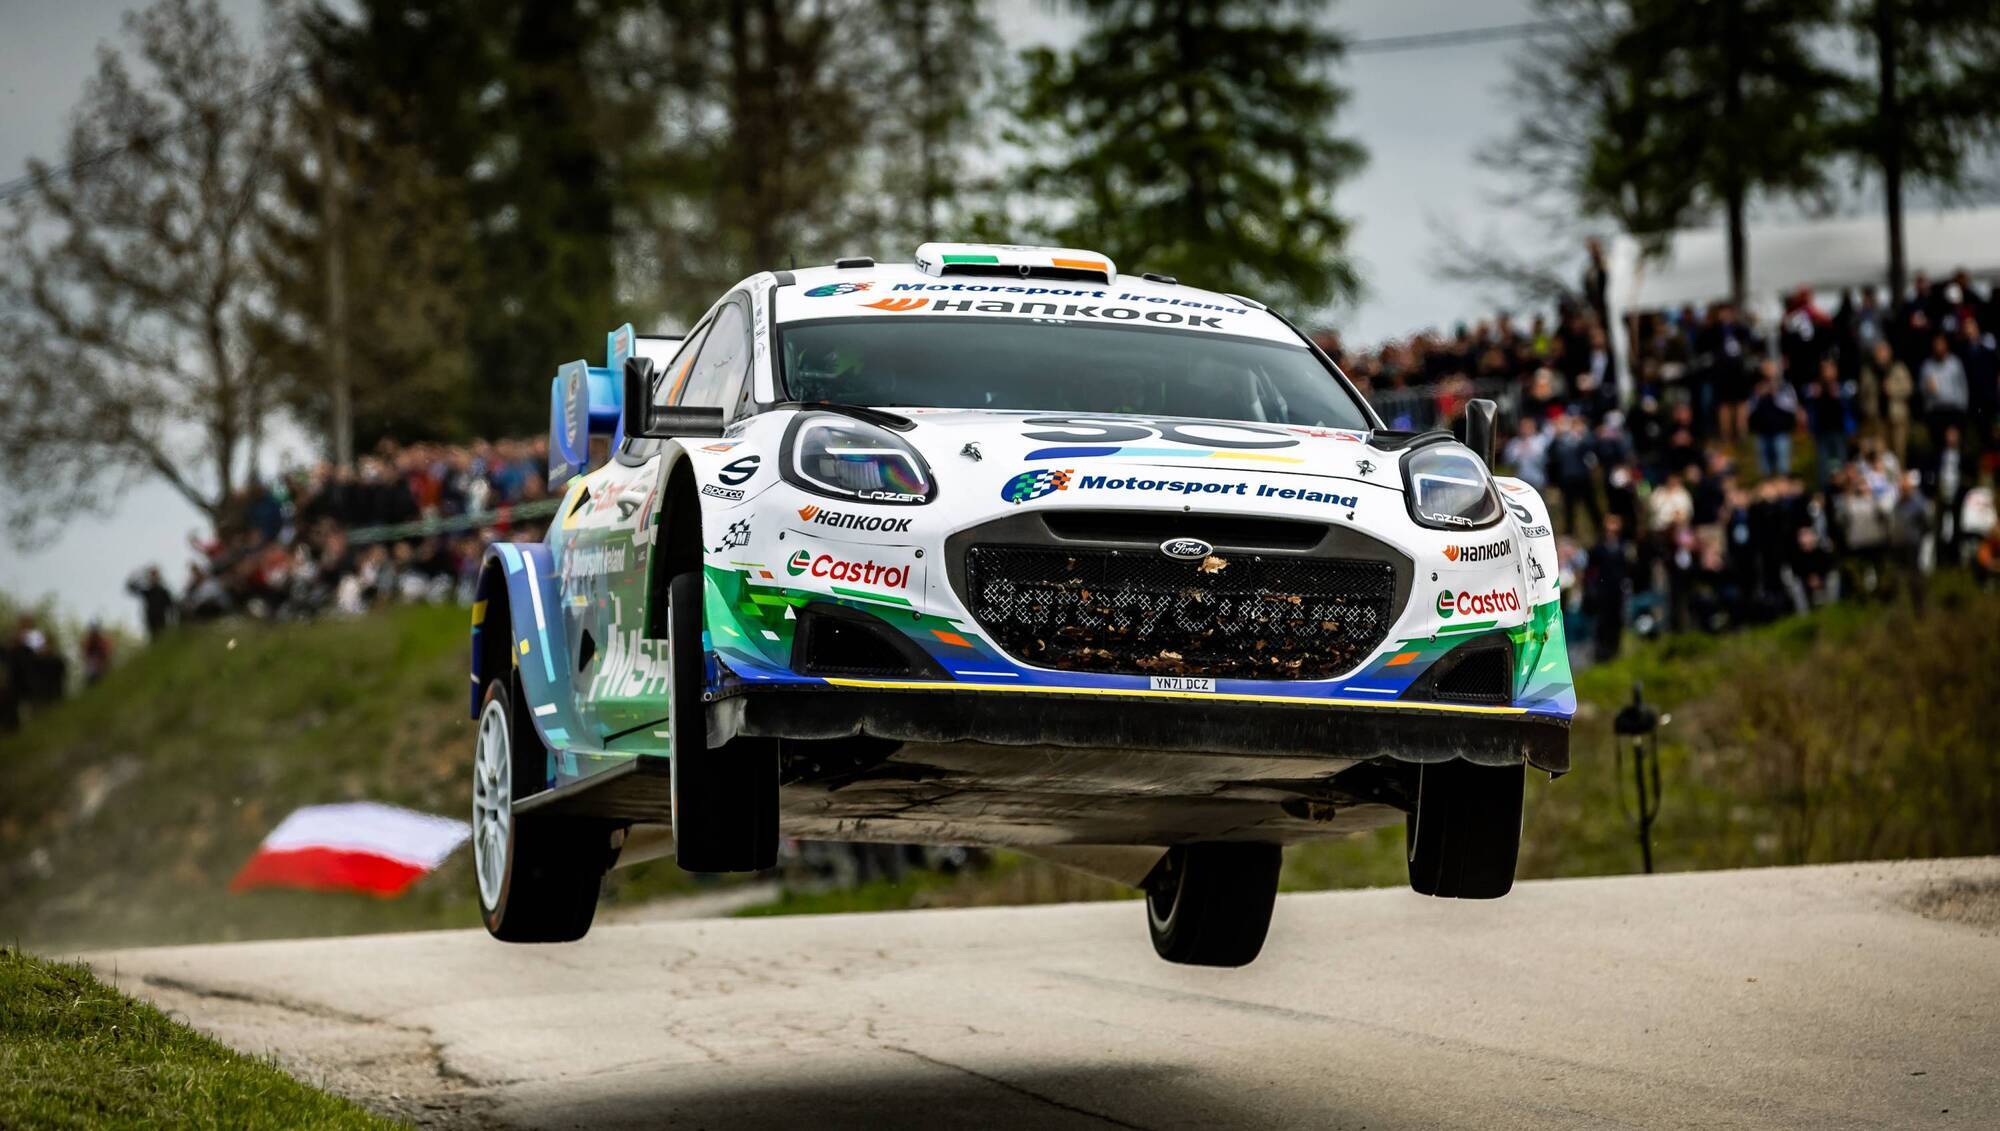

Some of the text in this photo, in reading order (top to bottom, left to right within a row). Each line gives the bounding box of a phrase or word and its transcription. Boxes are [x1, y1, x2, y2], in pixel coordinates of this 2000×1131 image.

[891, 283, 1249, 316] Motorsport Ireland
[703, 485, 744, 499] sparco
[858, 490, 926, 503] LAZER
[1079, 475, 1358, 508] Motorsport Ireland
[1172, 541, 1202, 555] Ford
[811, 554, 911, 589] Castrol
[1457, 588, 1521, 616] Castrol
[1156, 677, 1209, 691] YN71 DCZ
